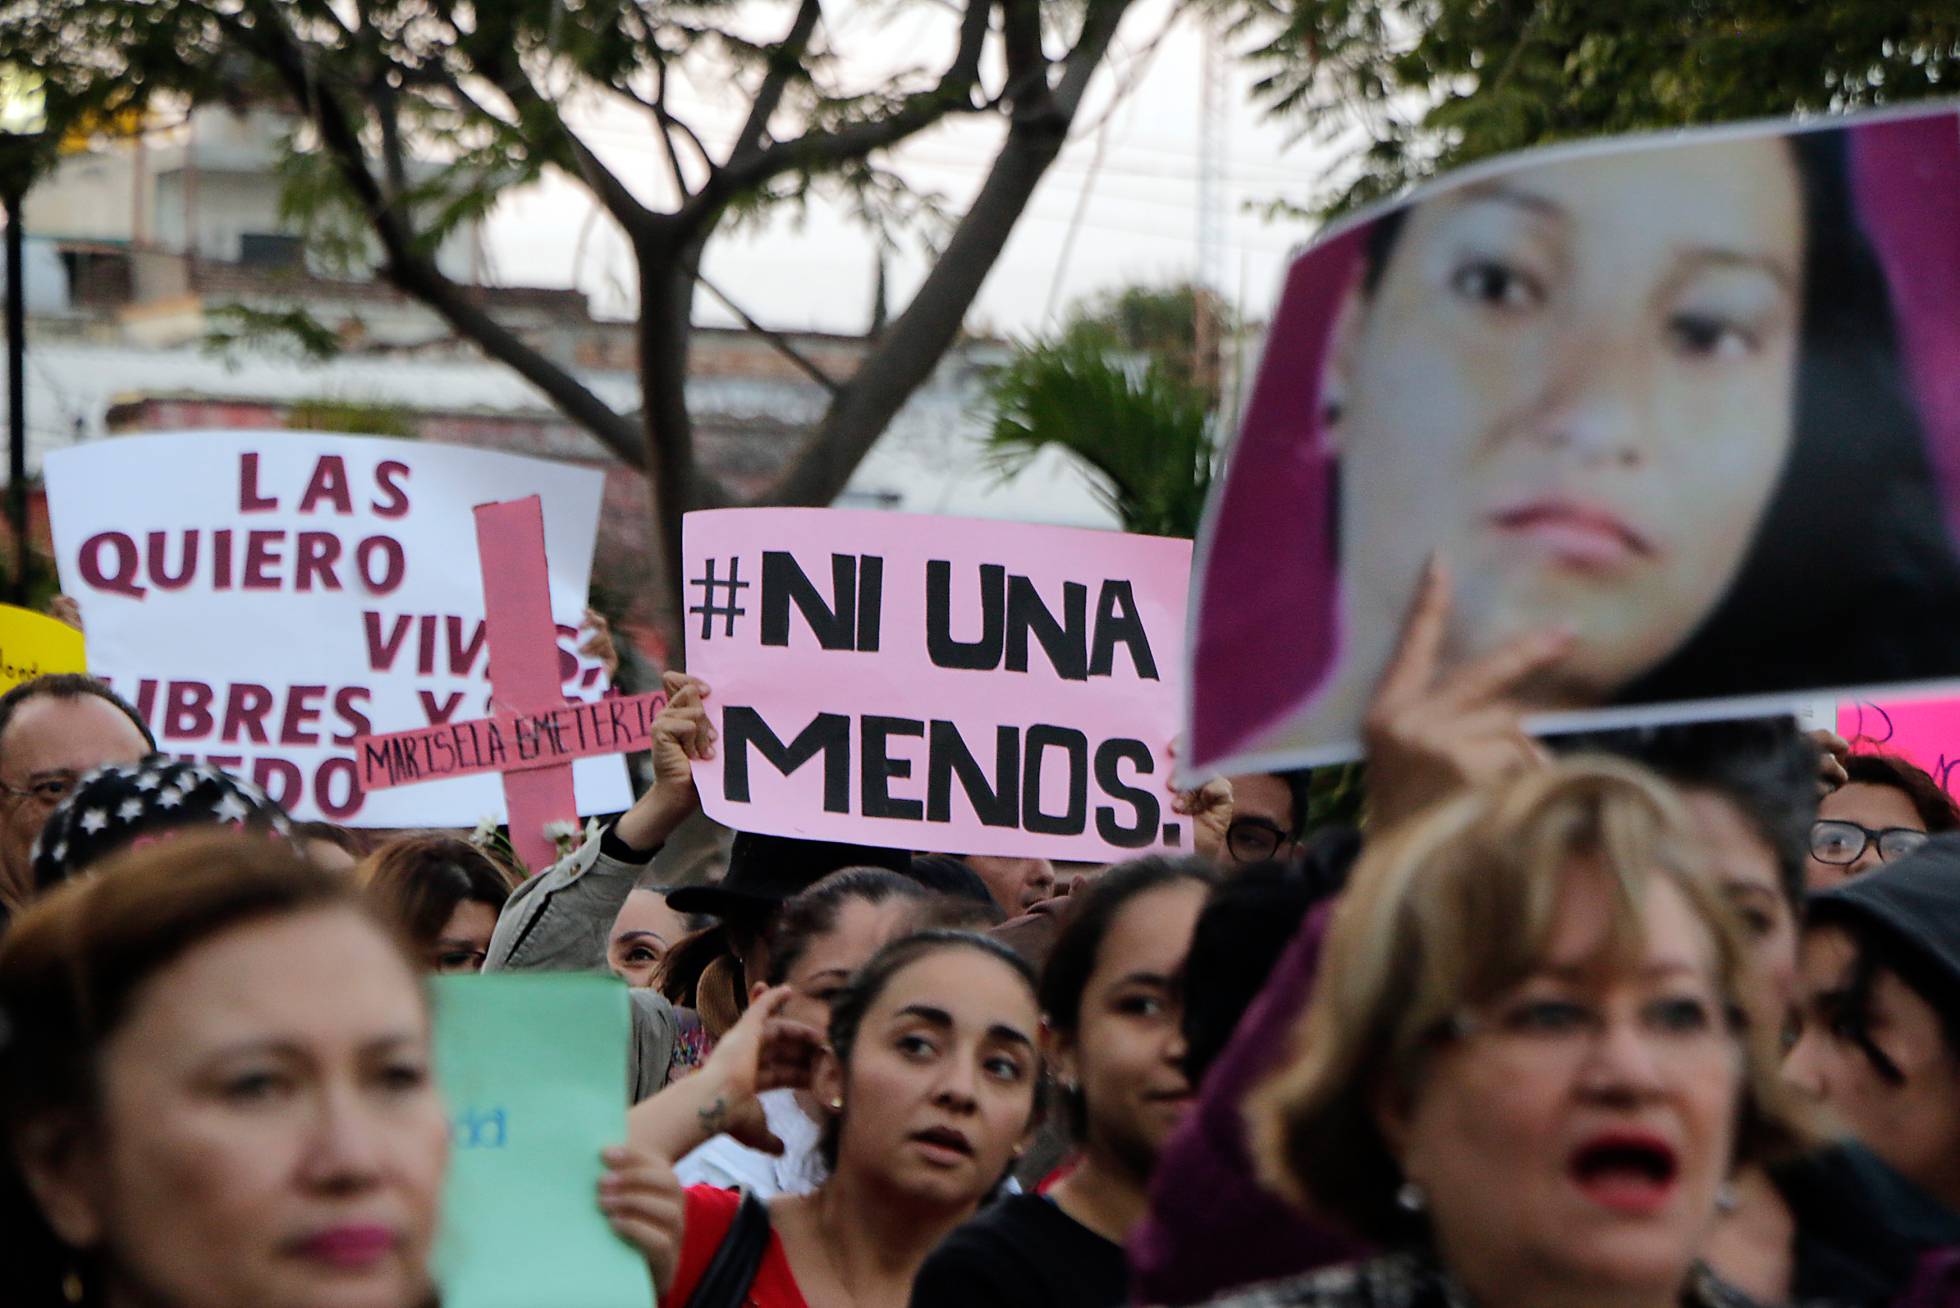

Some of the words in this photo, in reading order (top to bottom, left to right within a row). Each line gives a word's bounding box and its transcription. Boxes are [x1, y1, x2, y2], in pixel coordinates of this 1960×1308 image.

[238, 452, 411, 518] LAS
[77, 529, 406, 600] QUIERO
[364, 611, 602, 689] VIVS,
[925, 559, 1160, 681] UNA
[95, 676, 373, 746] IBRES
[364, 721, 506, 786] MARISELA
[721, 705, 1181, 848] MENOS.
